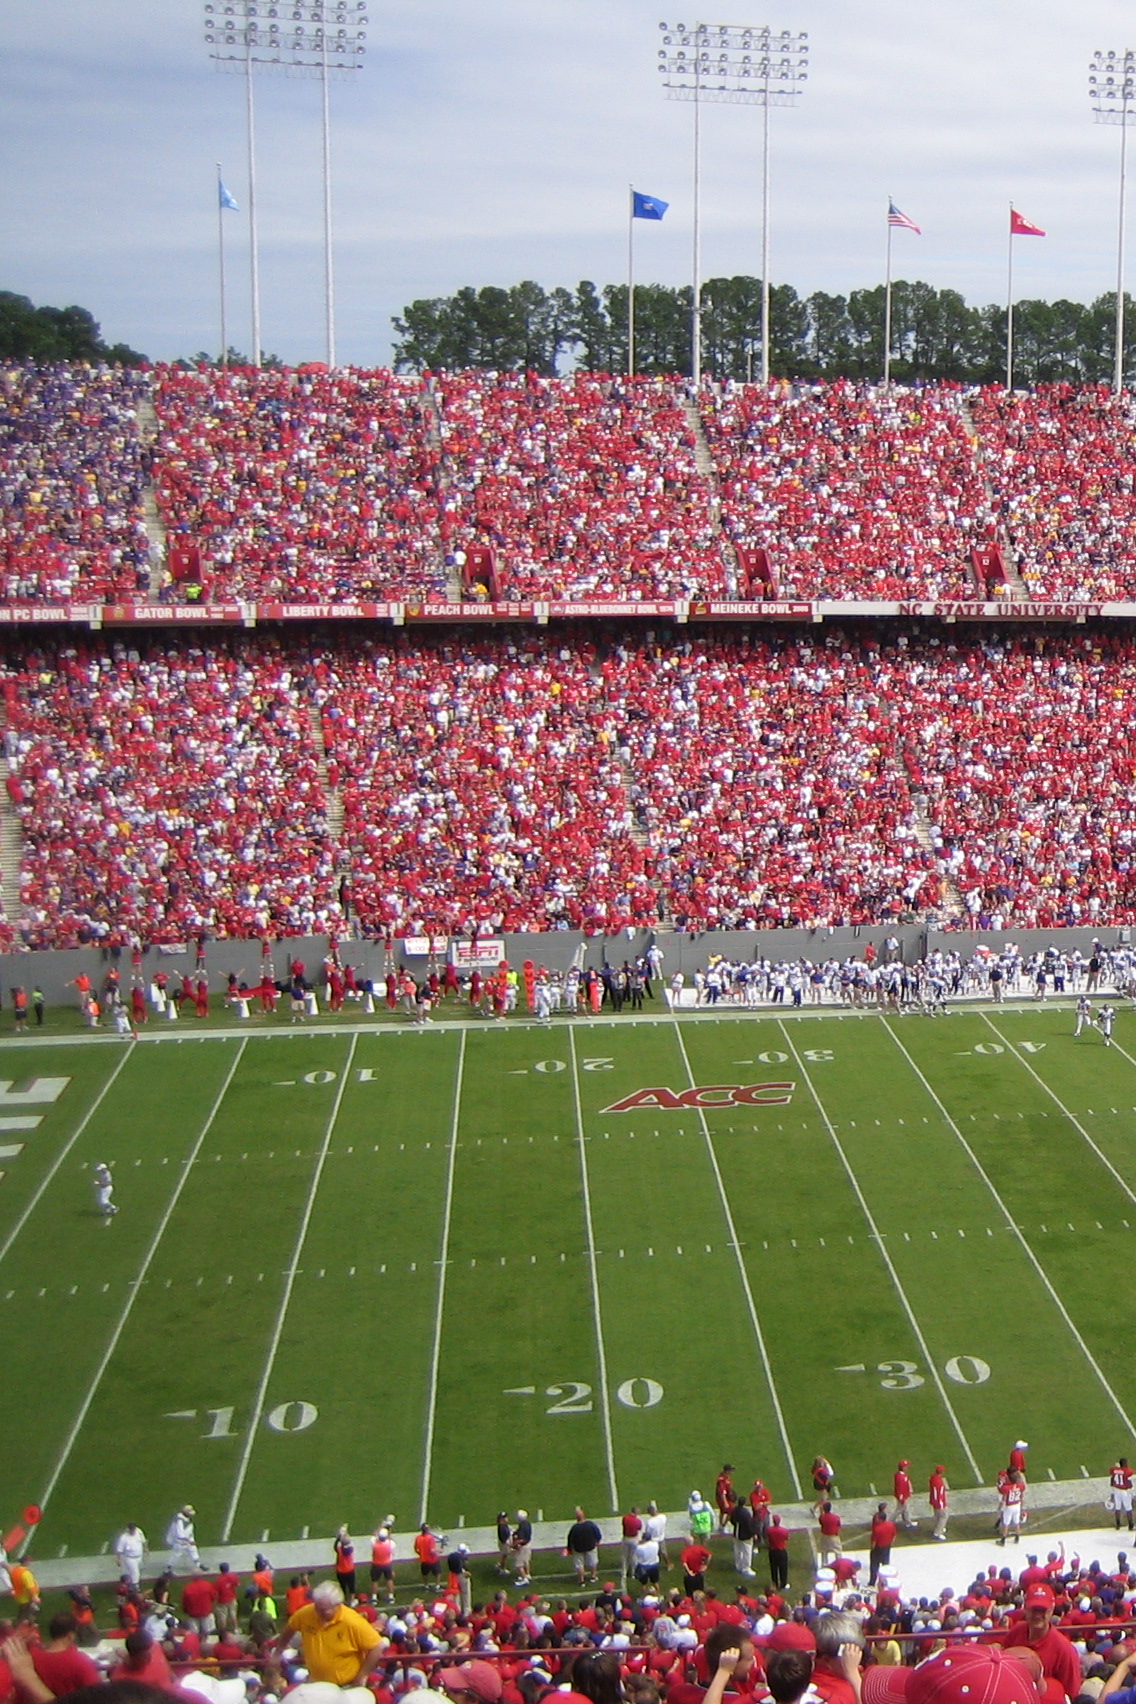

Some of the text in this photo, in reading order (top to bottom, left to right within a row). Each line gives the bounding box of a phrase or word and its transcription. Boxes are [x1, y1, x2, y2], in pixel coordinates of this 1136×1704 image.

[13, 608, 30, 620] PC
[32, 608, 68, 620] BOWL
[135, 607, 173, 618] GATOR
[175, 607, 209, 618] BOWL
[282, 605, 330, 617] LIBERTY
[332, 605, 365, 616] BOWL
[424, 604, 460, 615] PEACH
[463, 604, 494, 615] BOWL
[637, 604, 659, 614] BOWL
[710, 603, 759, 614] MEINEKE
[761, 603, 792, 614] BOWL
[899, 603, 1104, 616] NC STATE UNIVERSITY
[598, 1081, 796, 1113] ACC
[877, 1355, 991, 1390] 30
[545, 1376, 664, 1414] 20
[200, 1400, 318, 1439] 10
[1114, 1474, 1124, 1486] 41
